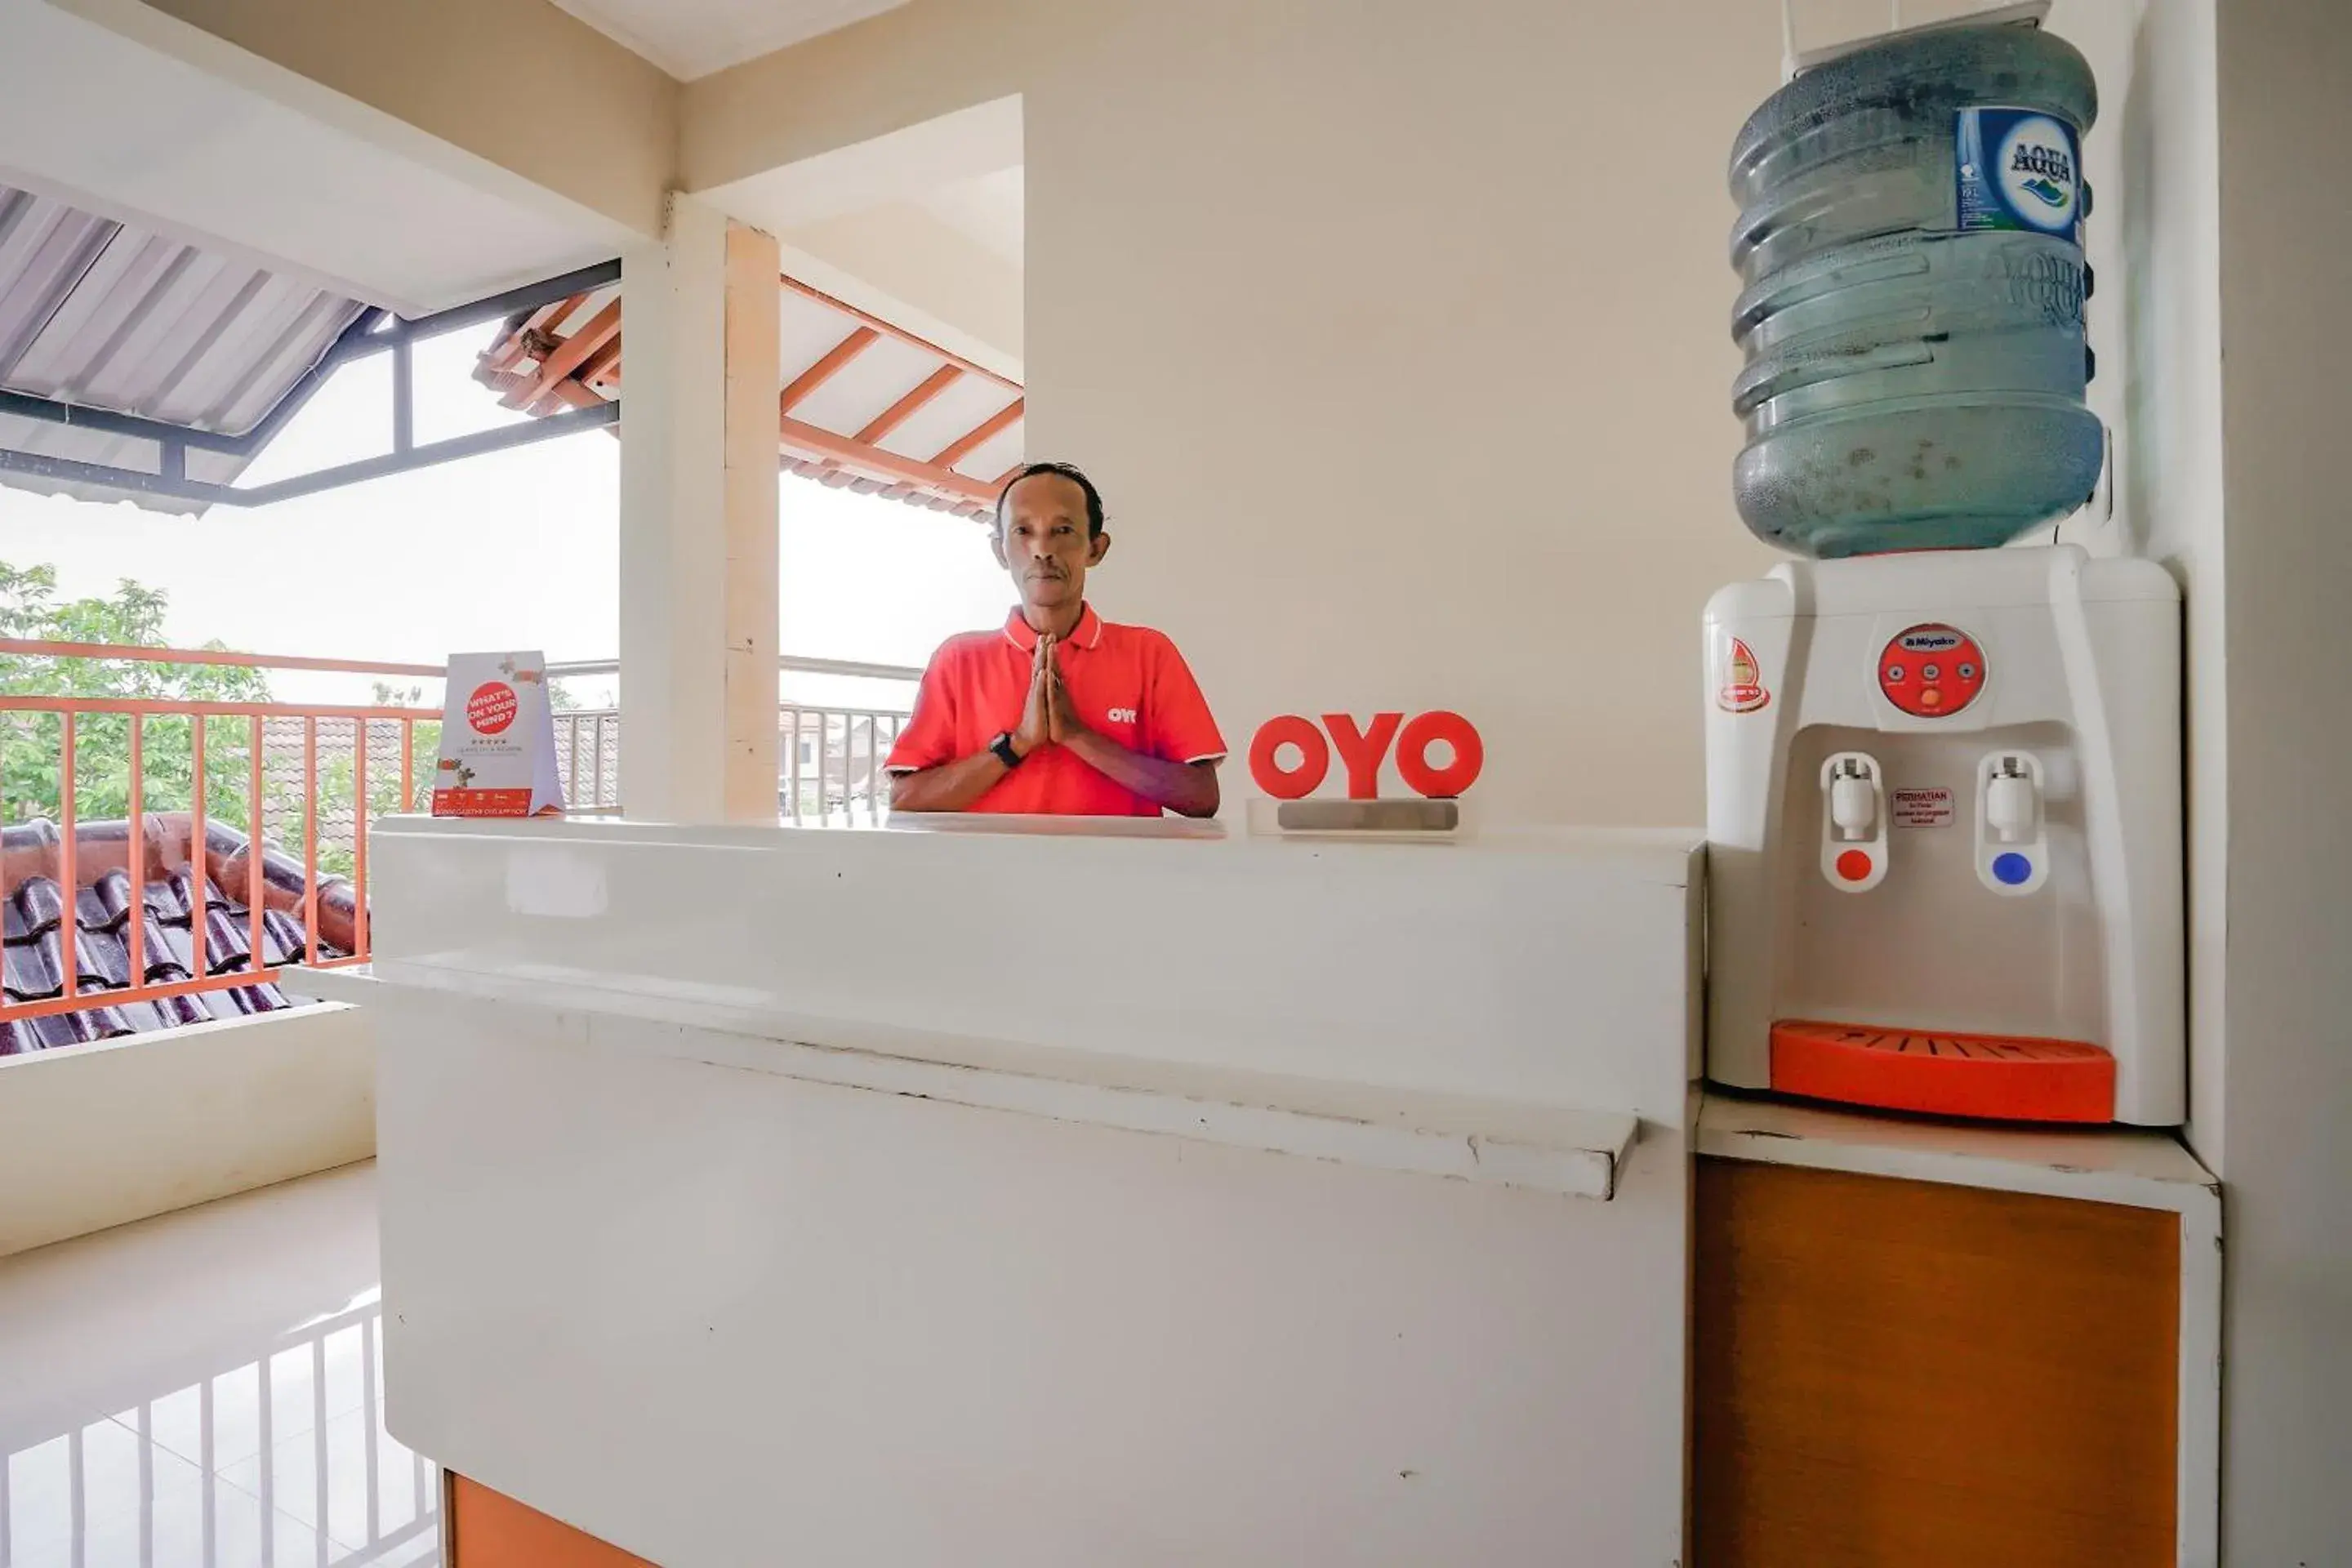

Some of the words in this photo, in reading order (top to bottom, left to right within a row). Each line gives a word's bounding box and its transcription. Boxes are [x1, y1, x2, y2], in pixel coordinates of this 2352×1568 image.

[2011, 142, 2071, 184] AQUA
[1916, 637, 1956, 648] Miyako
[470, 689, 512, 707] WHAT'S
[469, 709, 484, 719] ON
[486, 699, 515, 715] YOUR
[1249, 710, 1484, 800] OYO
